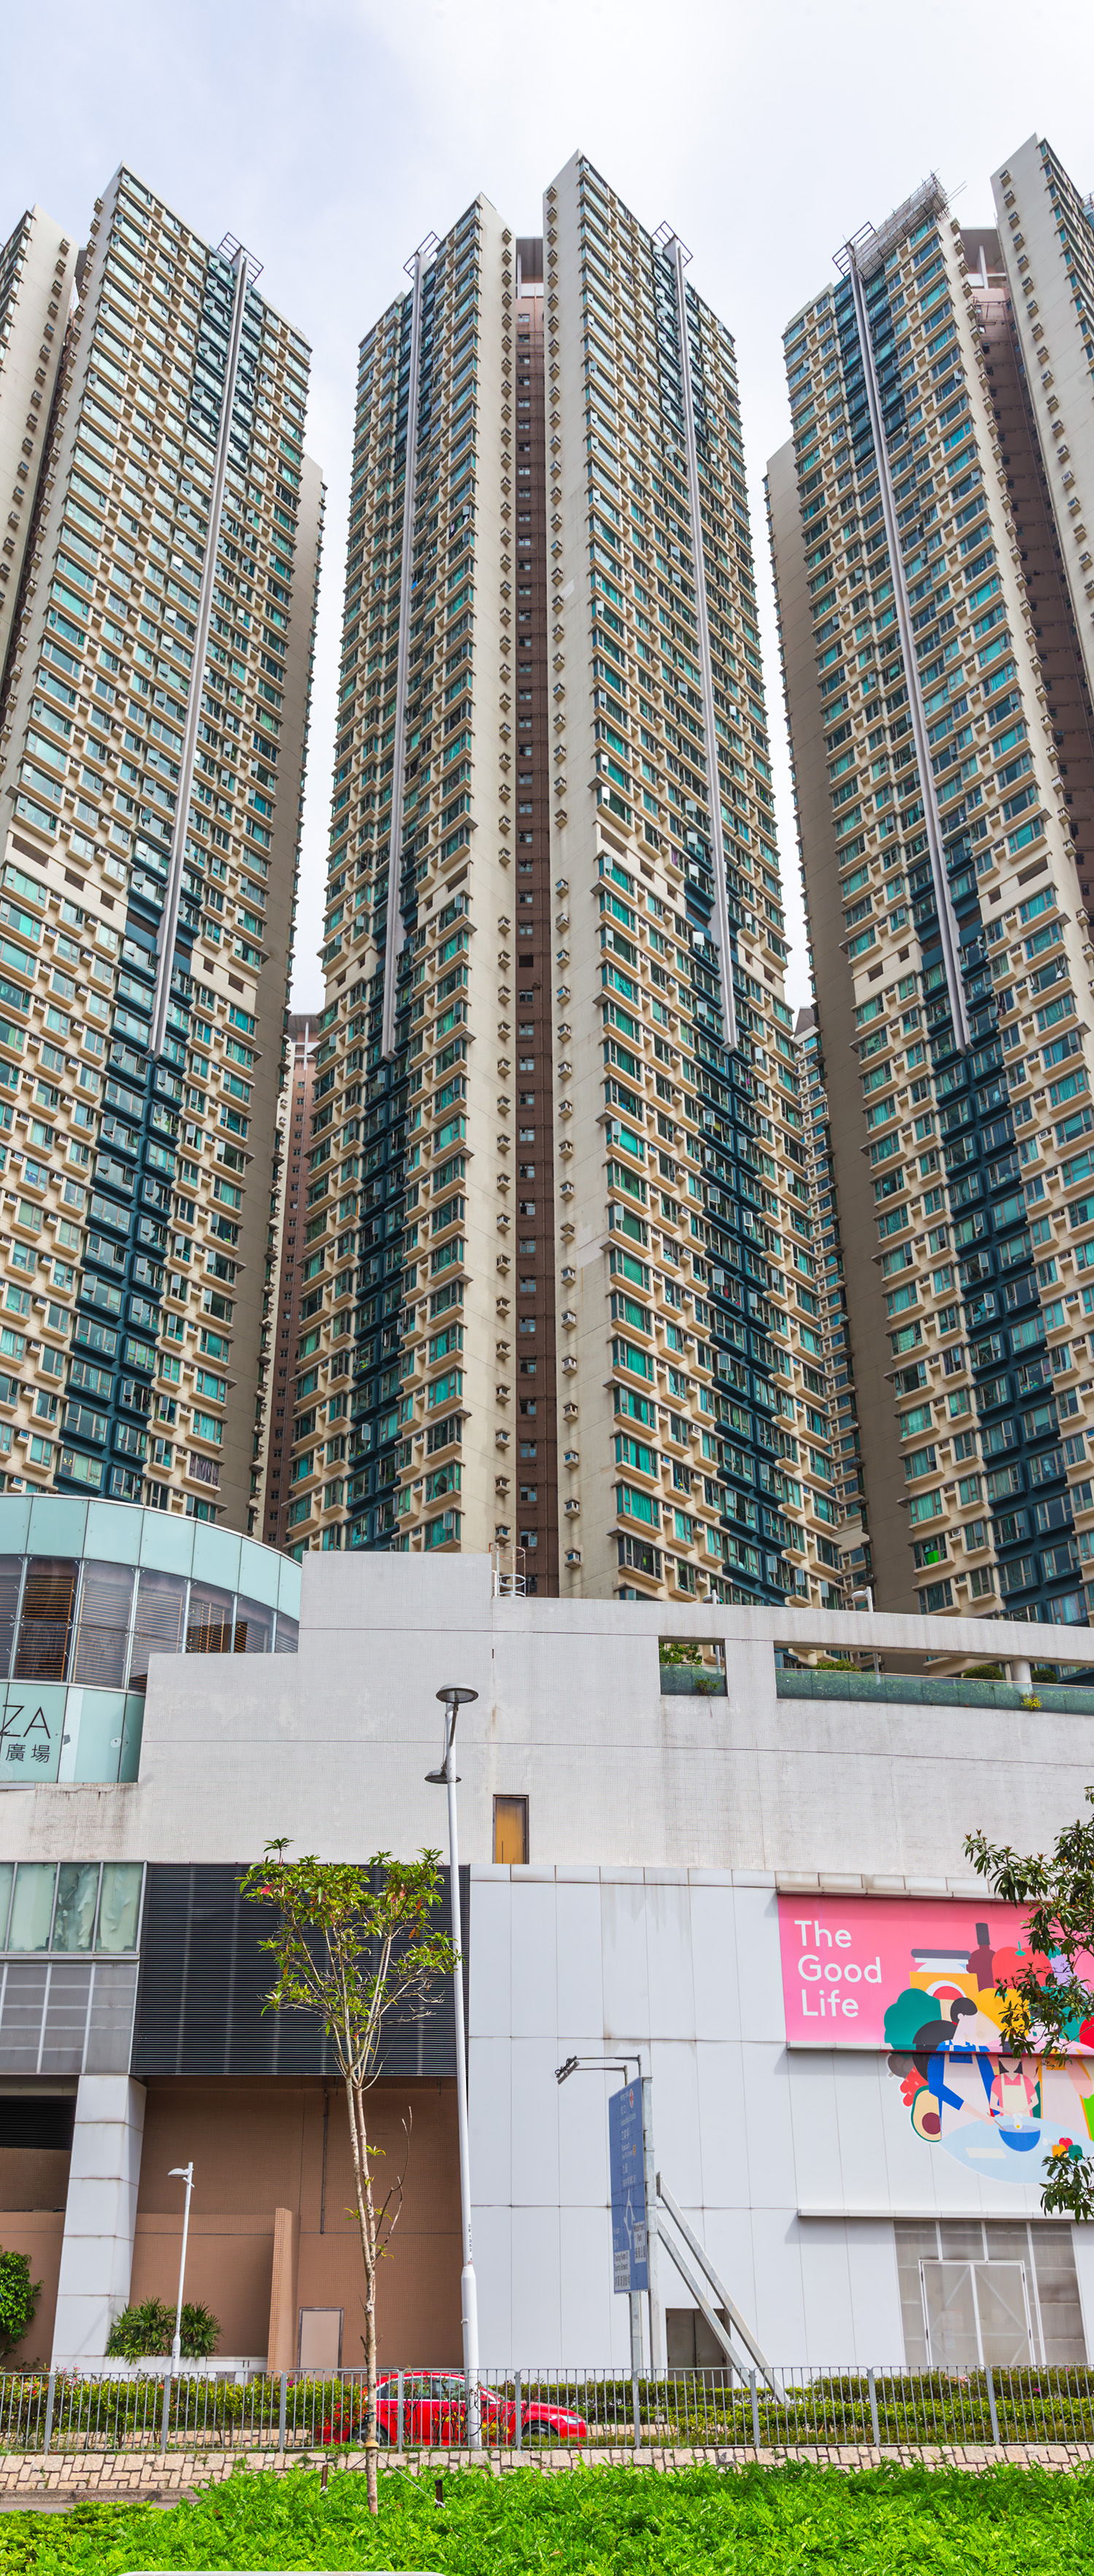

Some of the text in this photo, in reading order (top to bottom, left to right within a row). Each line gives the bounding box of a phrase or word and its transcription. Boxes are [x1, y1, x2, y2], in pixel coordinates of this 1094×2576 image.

[0, 1705, 51, 1739] ZA
[5, 1743, 50, 1763] 廣場
[794, 1920, 852, 1947] The
[798, 1954, 882, 1983] Good
[802, 1989, 858, 2017] Life
